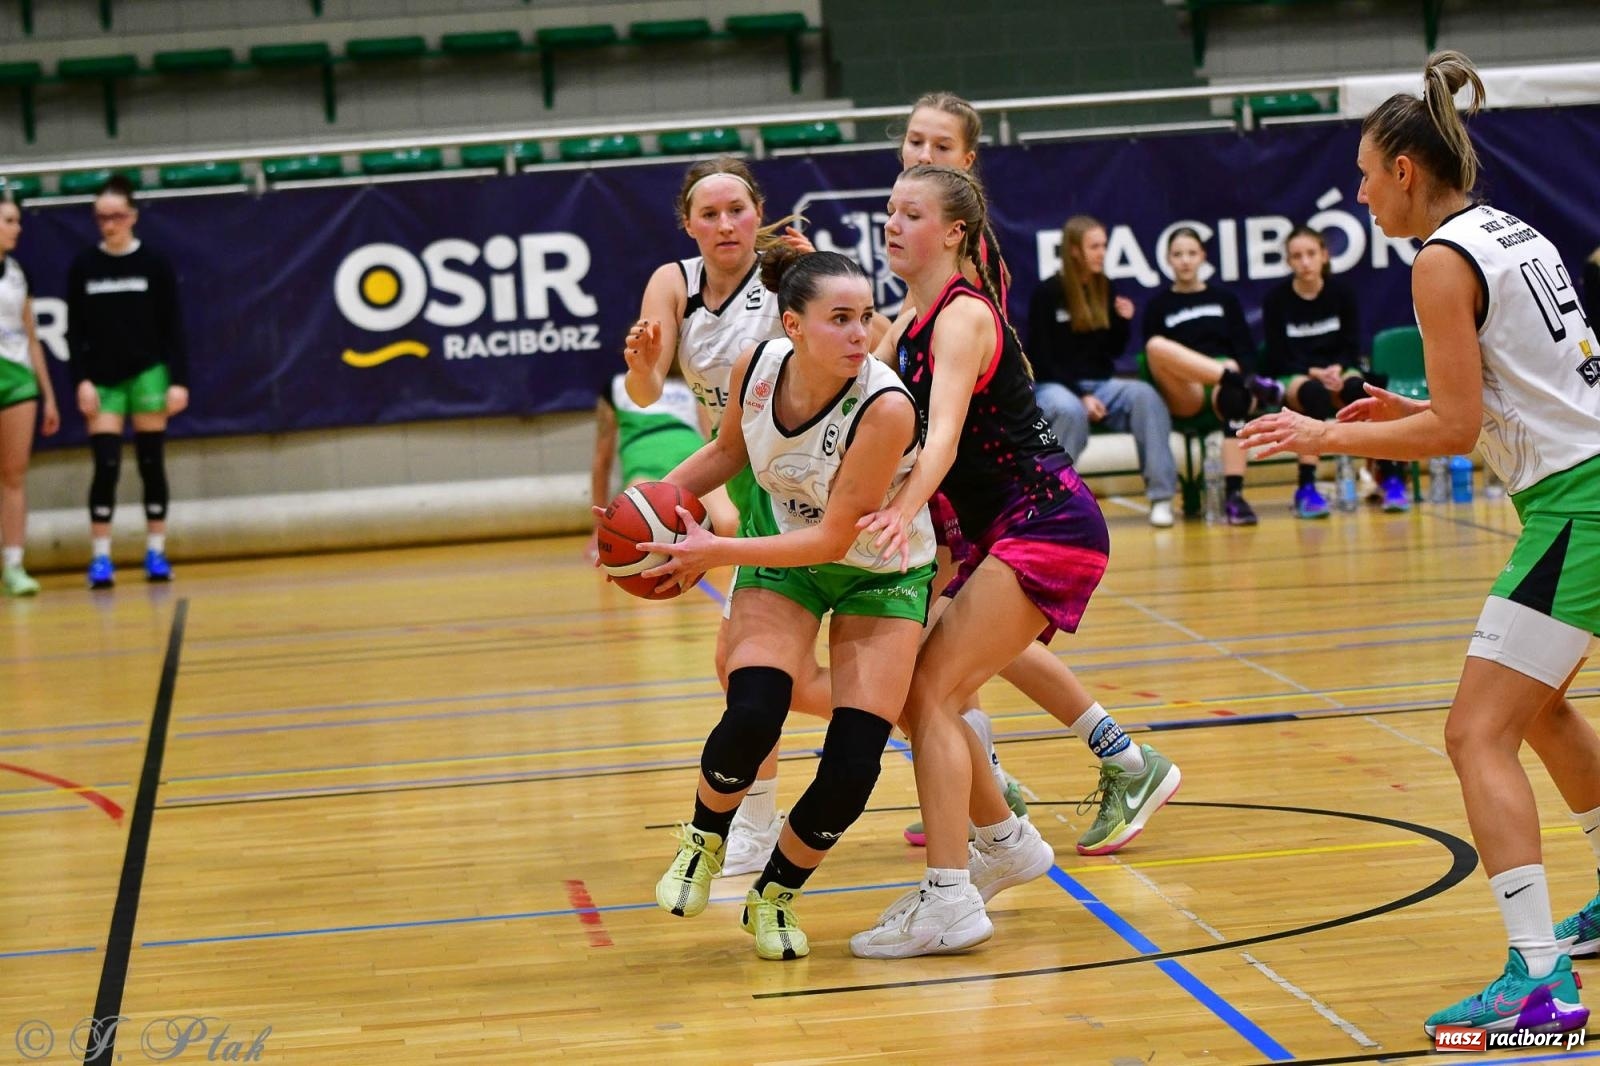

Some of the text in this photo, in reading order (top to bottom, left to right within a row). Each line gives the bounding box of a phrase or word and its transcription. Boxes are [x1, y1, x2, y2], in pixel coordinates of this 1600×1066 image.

[334, 232, 599, 332] OSiR
[443, 321, 601, 360] RACIBÓRZ
[822, 423, 840, 456] 8
